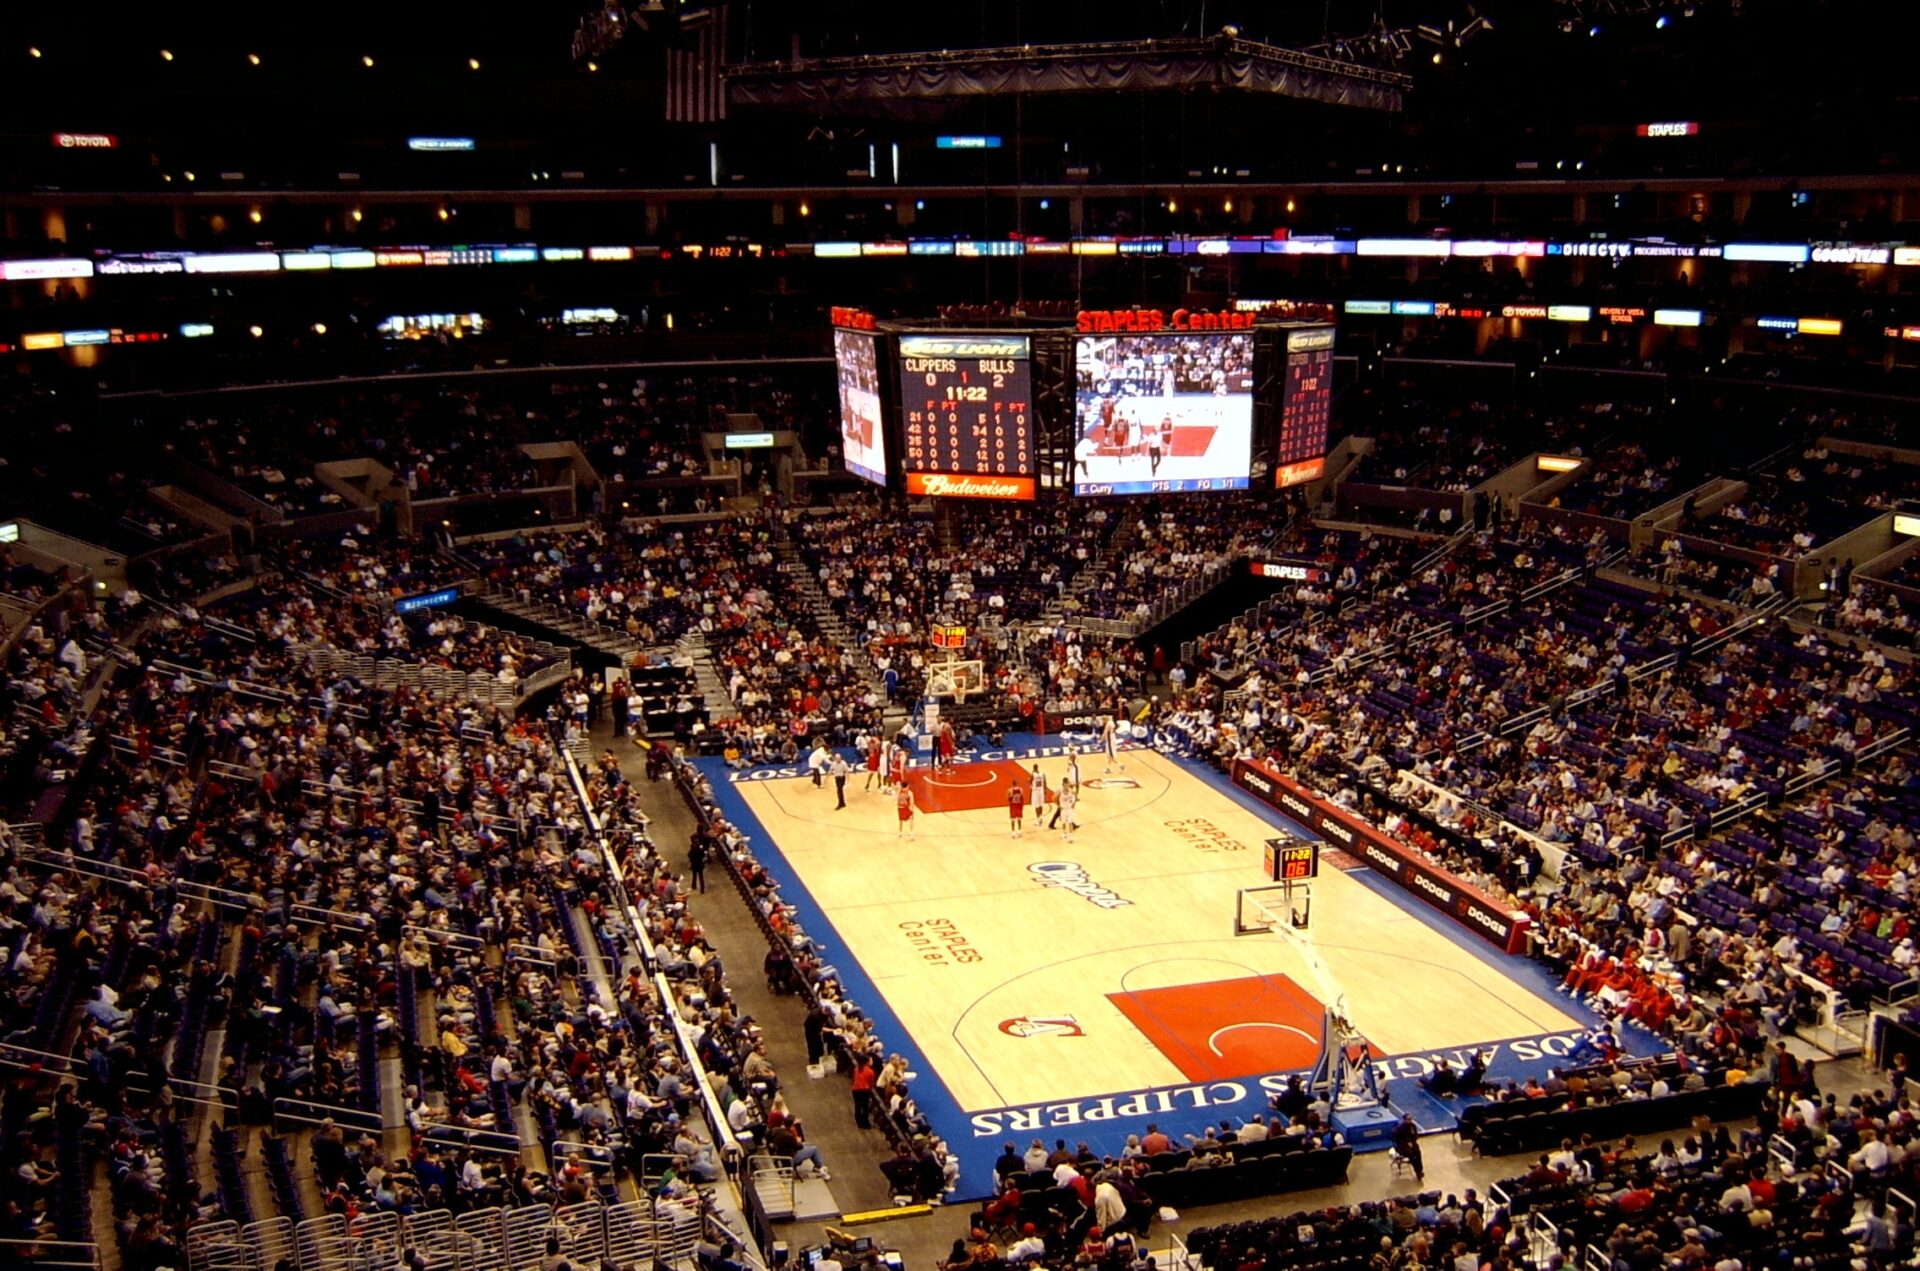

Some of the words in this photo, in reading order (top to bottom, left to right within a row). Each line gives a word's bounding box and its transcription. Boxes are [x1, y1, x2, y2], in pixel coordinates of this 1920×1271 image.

[1648, 124, 1688, 137] STAPLES
[75, 136, 111, 147] TOYOTA
[1563, 244, 1629, 257] DIRECTV
[1812, 248, 1888, 263] GOODYEAR
[1515, 307, 1546, 317] TOYOTA
[1076, 310, 1163, 332] STAPLES
[1172, 309, 1257, 331] Center
[1309, 336, 1331, 346] LIGHT
[956, 345, 1022, 355] LIGHT
[906, 359, 956, 372] CLIPPERS
[979, 360, 1015, 373] BULLS
[926, 373, 937, 386] 0
[961, 371, 968, 384] 1
[993, 374, 1004, 388] 2
[946, 387, 987, 401] 11:22
[928, 401, 935, 410] F
[942, 401, 957, 411] PT
[994, 403, 1002, 412] F
[1010, 403, 1025, 412] PT
[910, 412, 921, 422] 21
[928, 412, 936, 422] 0
[949, 412, 957, 422] 0
[995, 414, 1000, 424] 1
[1017, 415, 1024, 425] 0
[908, 424, 921, 433] 42
[929, 424, 936, 434] 0
[950, 425, 957, 435] 0
[972, 425, 987, 436] 34
[995, 426, 1003, 436] 0
[1017, 427, 1025, 437] 0
[929, 436, 936, 446] 0
[950, 437, 958, 447] 0
[980, 438, 987, 448] 2
[996, 438, 1004, 448] 0
[1018, 439, 1026, 450] 2
[930, 448, 937, 458] 0
[951, 449, 958, 459] 0
[976, 450, 988, 460] 12
[996, 451, 1004, 461] 0
[1018, 451, 1026, 461] 0
[930, 460, 938, 470] 0
[952, 461, 959, 471] 0
[977, 462, 988, 472] 21
[997, 463, 1005, 473] 0
[1019, 464, 1027, 474] 0
[922, 475, 1019, 495] Budweiser
[1080, 485, 1088, 494] E.
[1089, 484, 1113, 495] Curry
[1152, 481, 1169, 491] PTS
[1177, 481, 1183, 490] 2
[1198, 480, 1211, 489] FG
[1222, 479, 1233, 488] 1/1
[1263, 565, 1307, 579] STAPLES
[729, 767, 799, 782] LOS
[1243, 771, 1271, 793] DODGE
[1281, 793, 1310, 817] DODGE
[1164, 820, 1219, 854] Center
[1186, 817, 1247, 853] STAPLES
[1321, 818, 1353, 843] DODGE
[1285, 849, 1311, 861] 11:22
[1365, 845, 1400, 872] DODGE
[1286, 861, 1306, 878] 06
[1413, 874, 1451, 903] DODGE
[1467, 907, 1507, 937] DODGE
[898, 920, 949, 966] Center
[925, 917, 984, 964] STAPLES
[970, 1081, 1248, 1138] CLIPPERS
